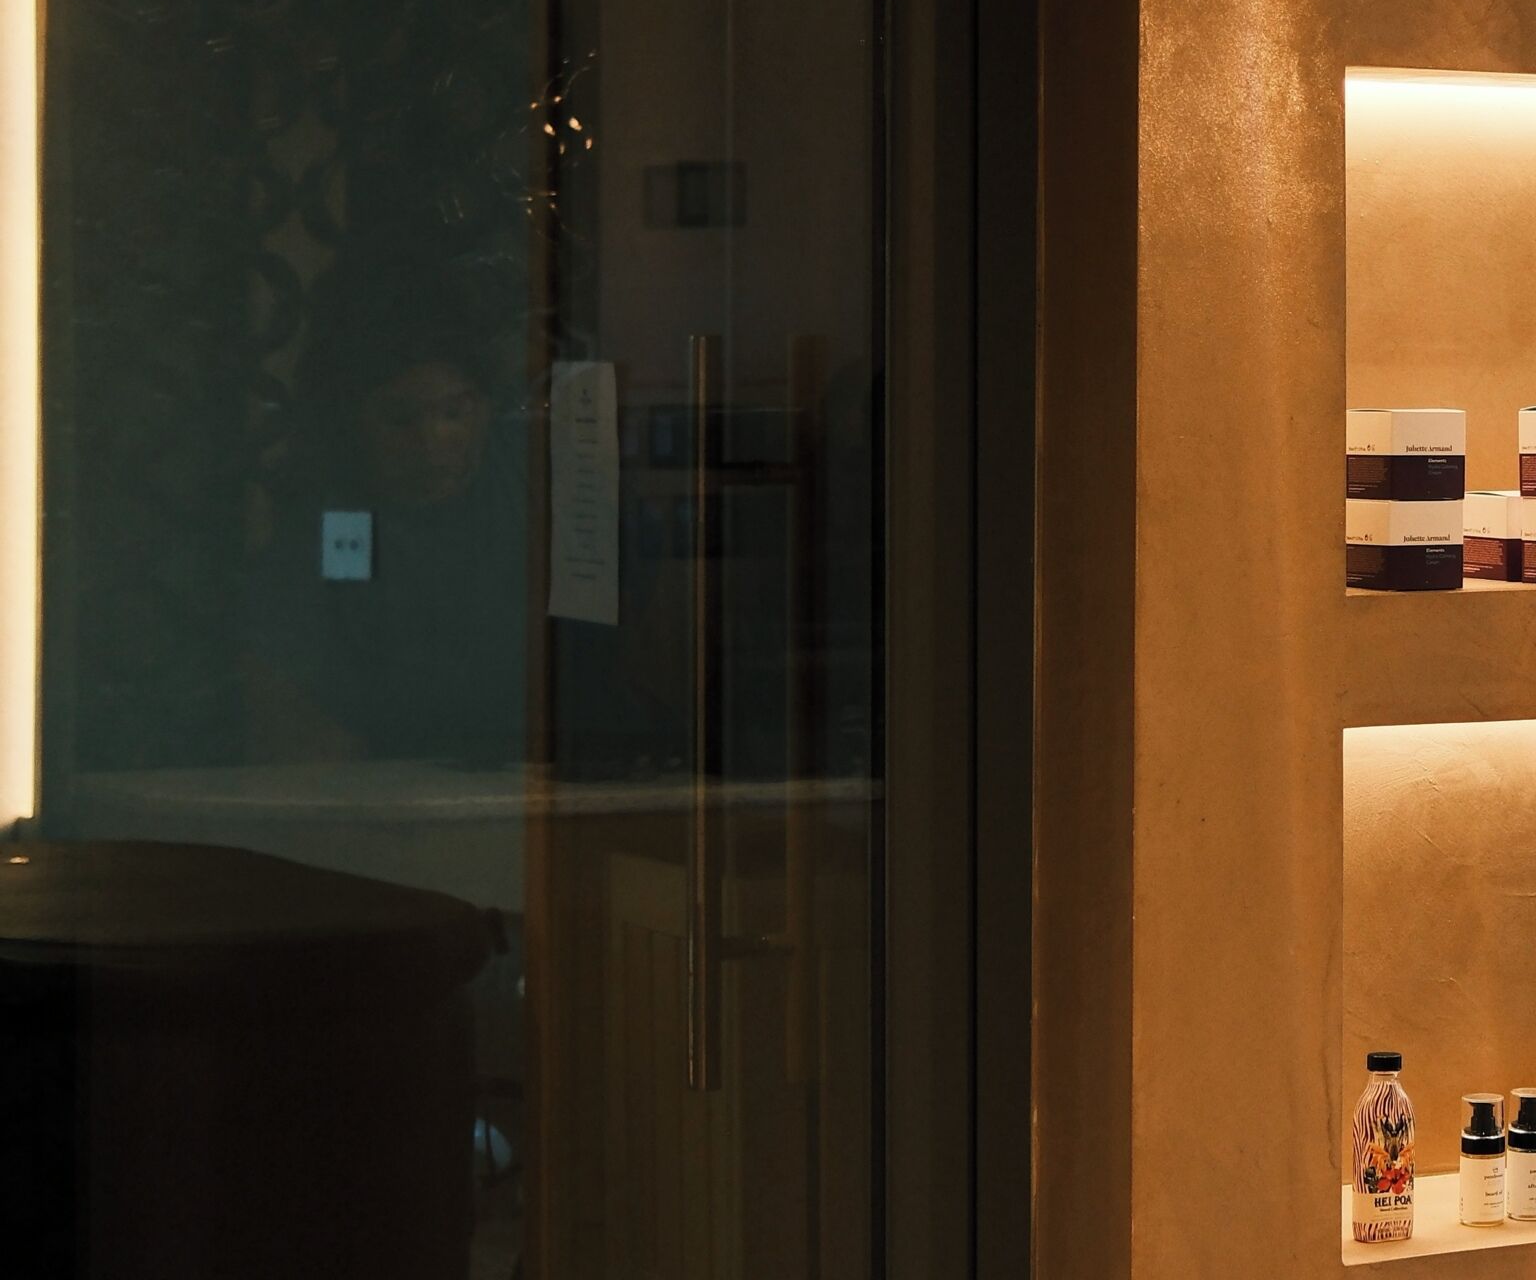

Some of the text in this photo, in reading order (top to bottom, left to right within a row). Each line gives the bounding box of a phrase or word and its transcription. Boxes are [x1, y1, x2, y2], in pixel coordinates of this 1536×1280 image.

[1405, 444, 1453, 453] Juliette Armand
[1403, 534, 1425, 542] Juliette
[1374, 1195, 1412, 1208] HEI POA
